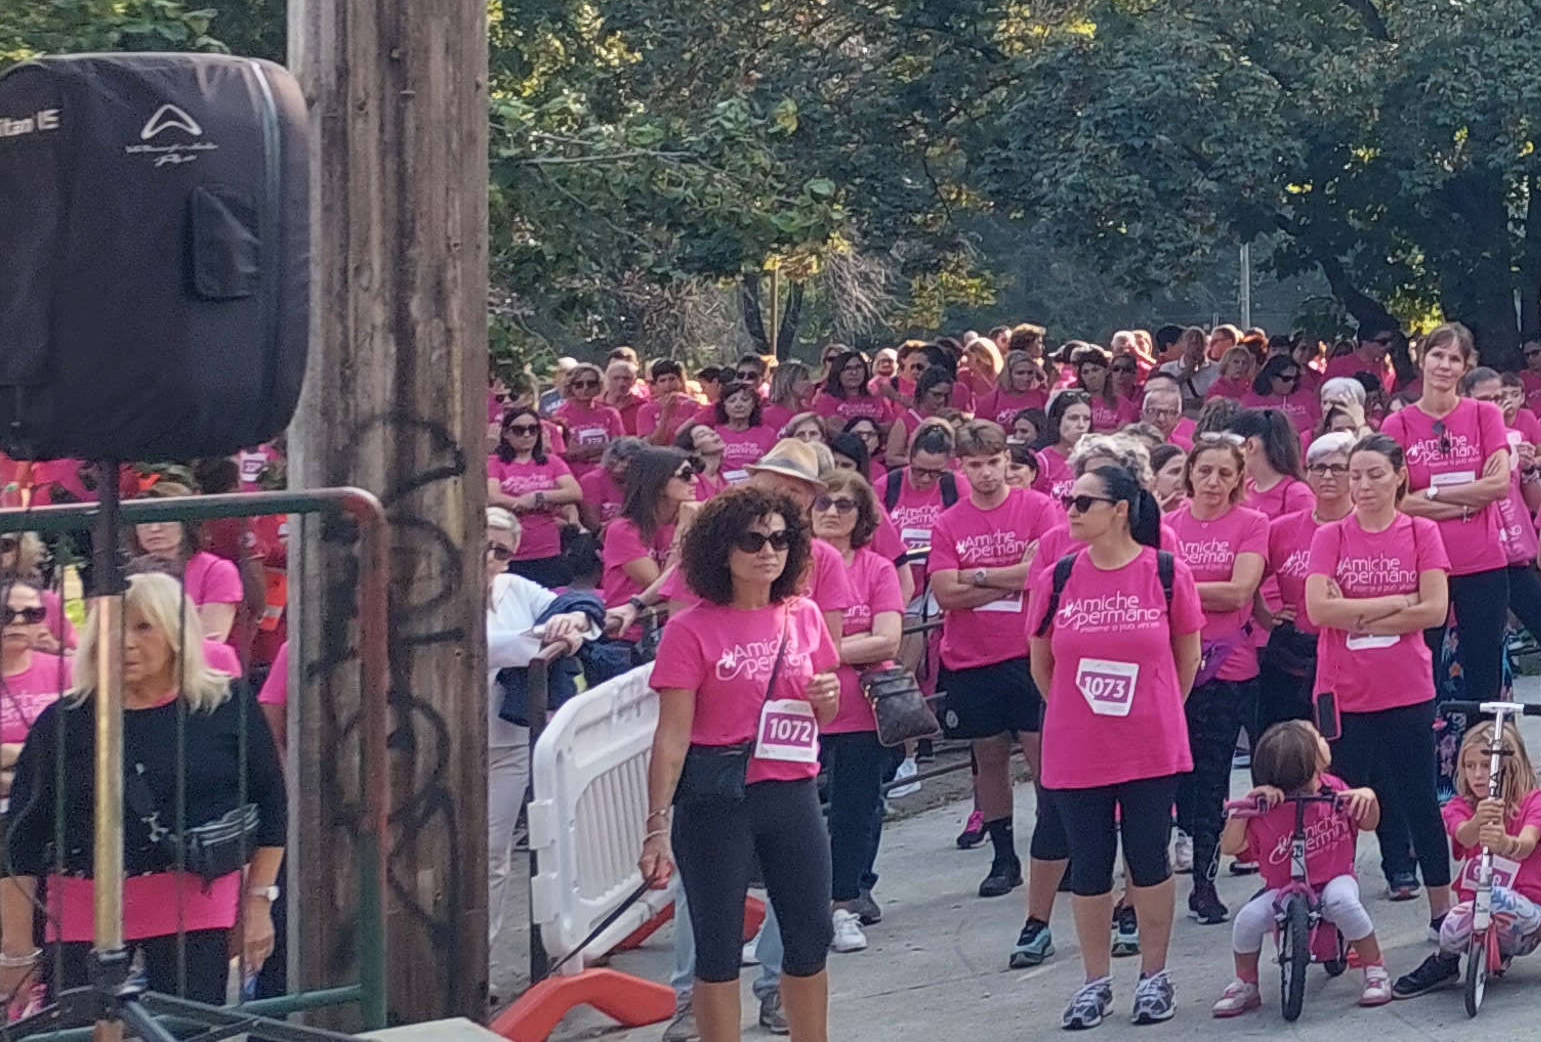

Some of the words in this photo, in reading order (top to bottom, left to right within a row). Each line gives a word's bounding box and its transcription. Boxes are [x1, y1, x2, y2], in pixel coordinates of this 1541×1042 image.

[1343, 553, 1400, 572] Amiche
[1073, 590, 1140, 613] Amiche
[1077, 608, 1161, 631] permano
[1083, 675, 1126, 699] 1073
[769, 717, 812, 743] 1072
